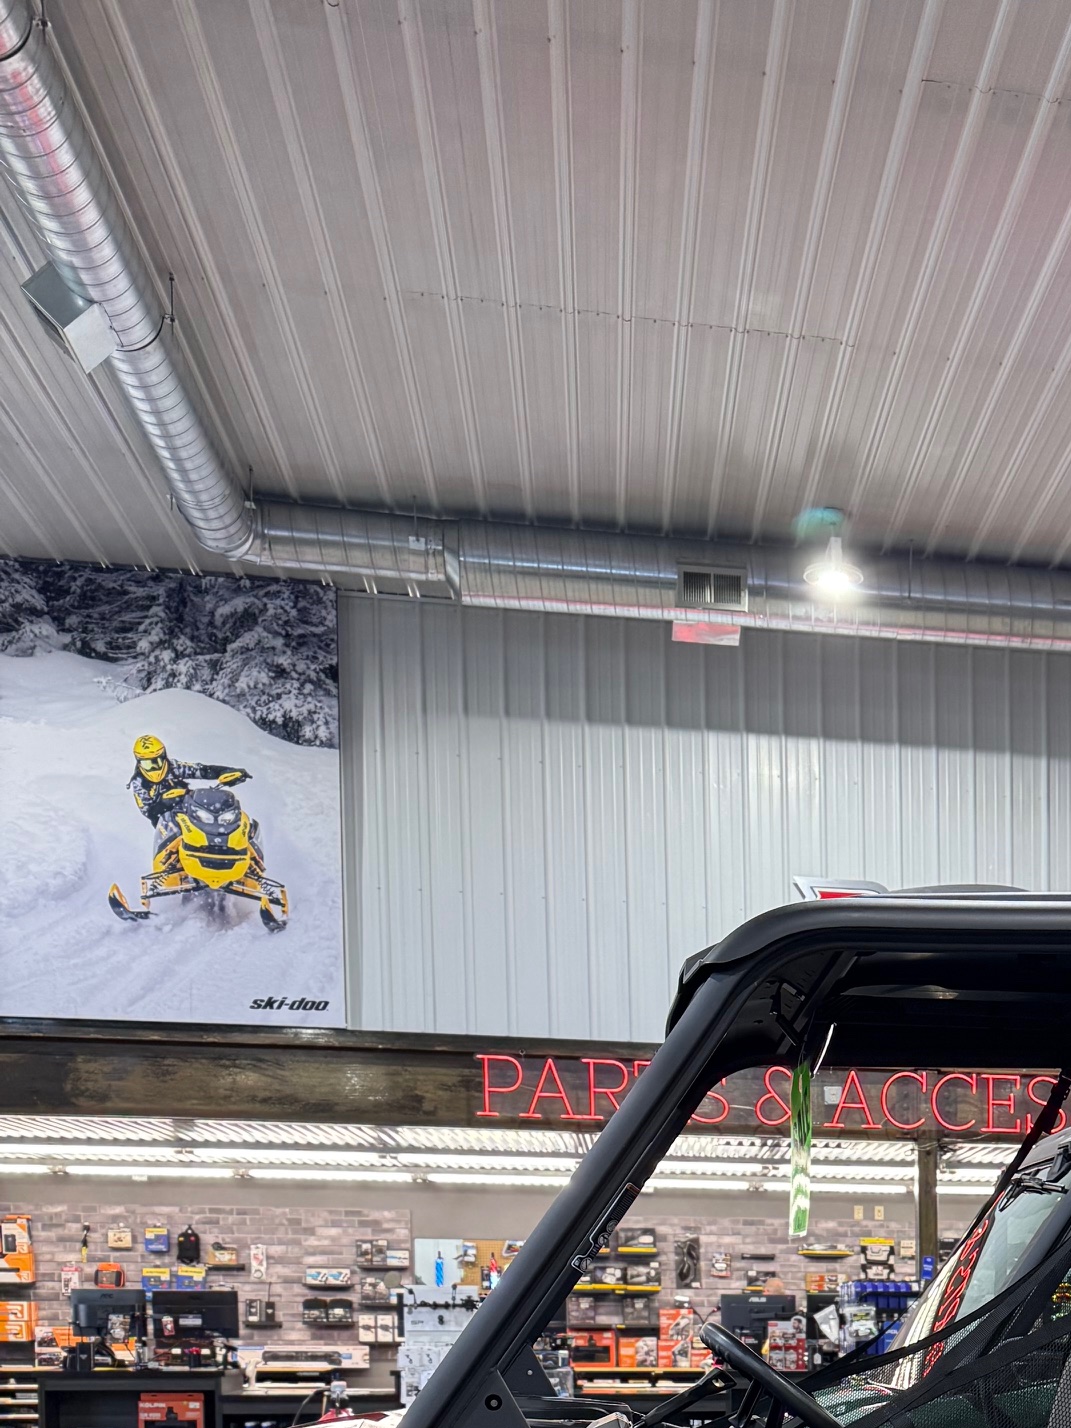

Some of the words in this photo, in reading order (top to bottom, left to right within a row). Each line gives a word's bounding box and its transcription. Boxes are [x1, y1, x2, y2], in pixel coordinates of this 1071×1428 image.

[249, 996, 329, 1011] ski-doo
[475, 1054, 730, 1125] PARS
[755, 1065, 801, 1126] &
